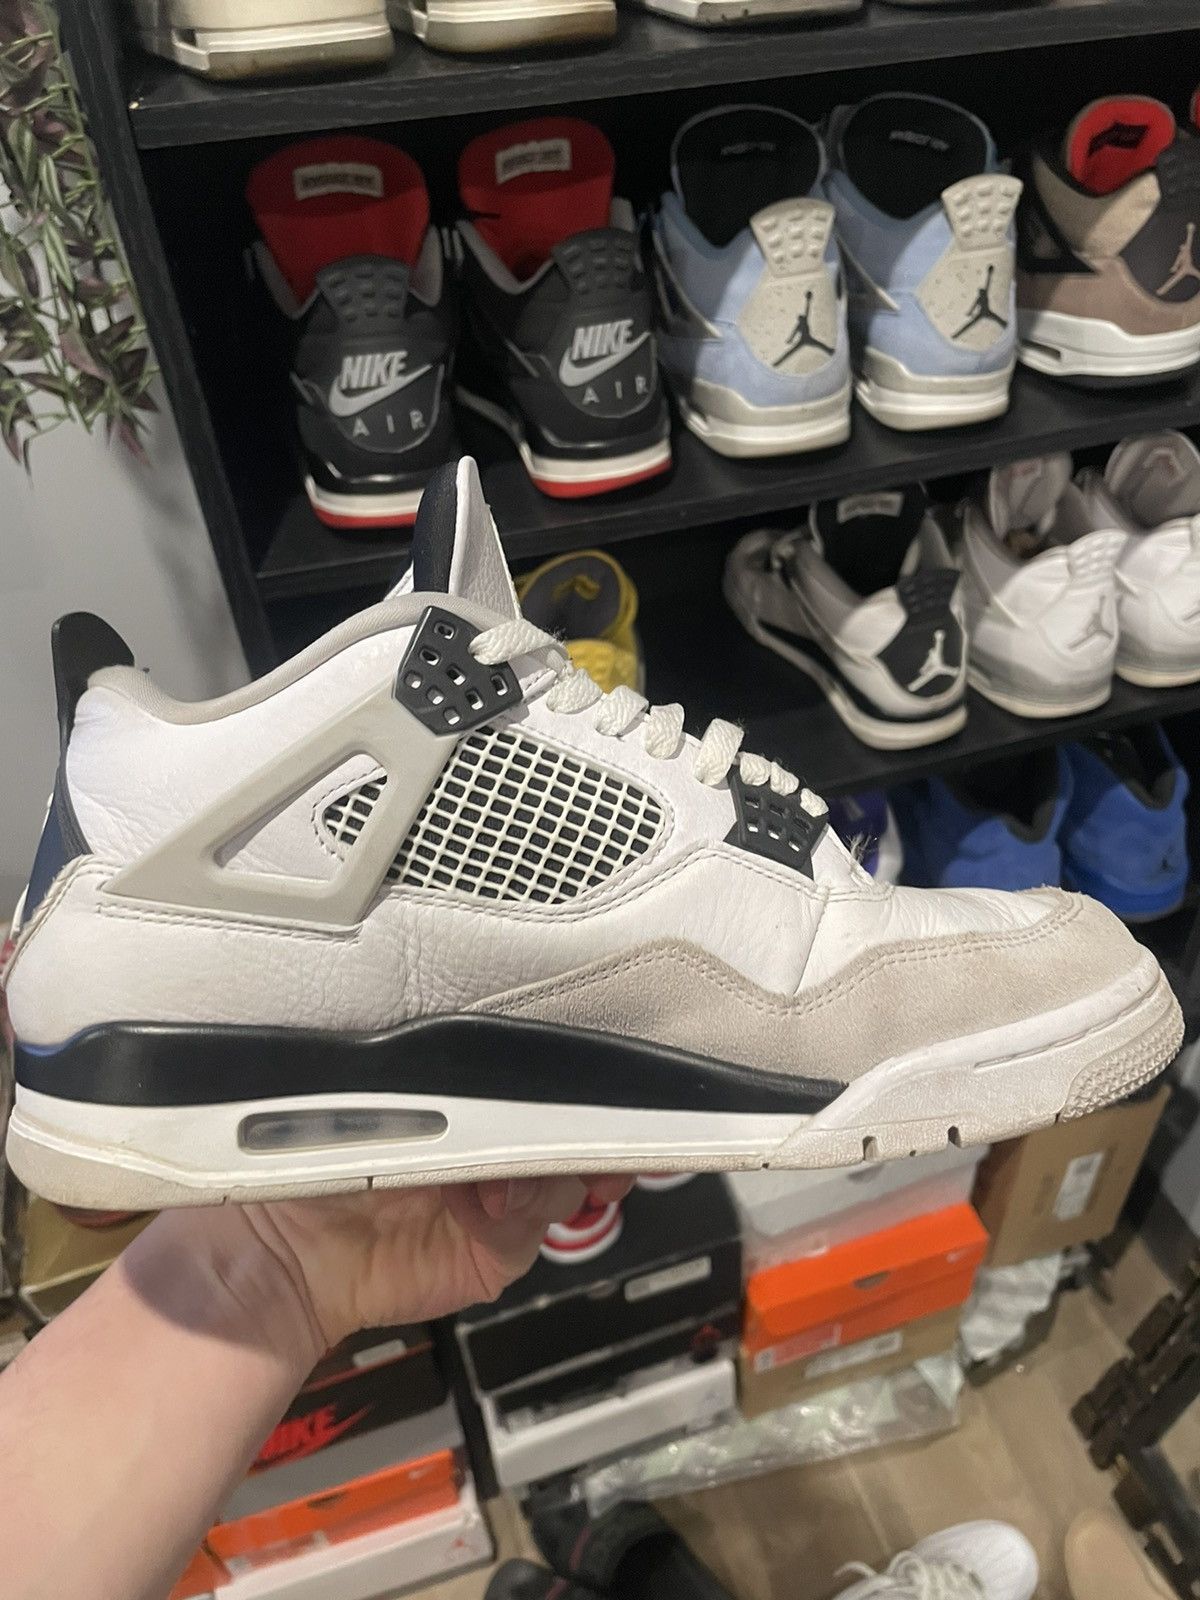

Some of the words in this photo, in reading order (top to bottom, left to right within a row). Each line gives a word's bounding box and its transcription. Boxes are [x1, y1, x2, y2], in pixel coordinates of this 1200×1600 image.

[571, 319, 634, 361] NIKE
[340, 351, 408, 389] NIKE
[582, 375, 649, 405] AIR
[352, 409, 426, 437] AIR
